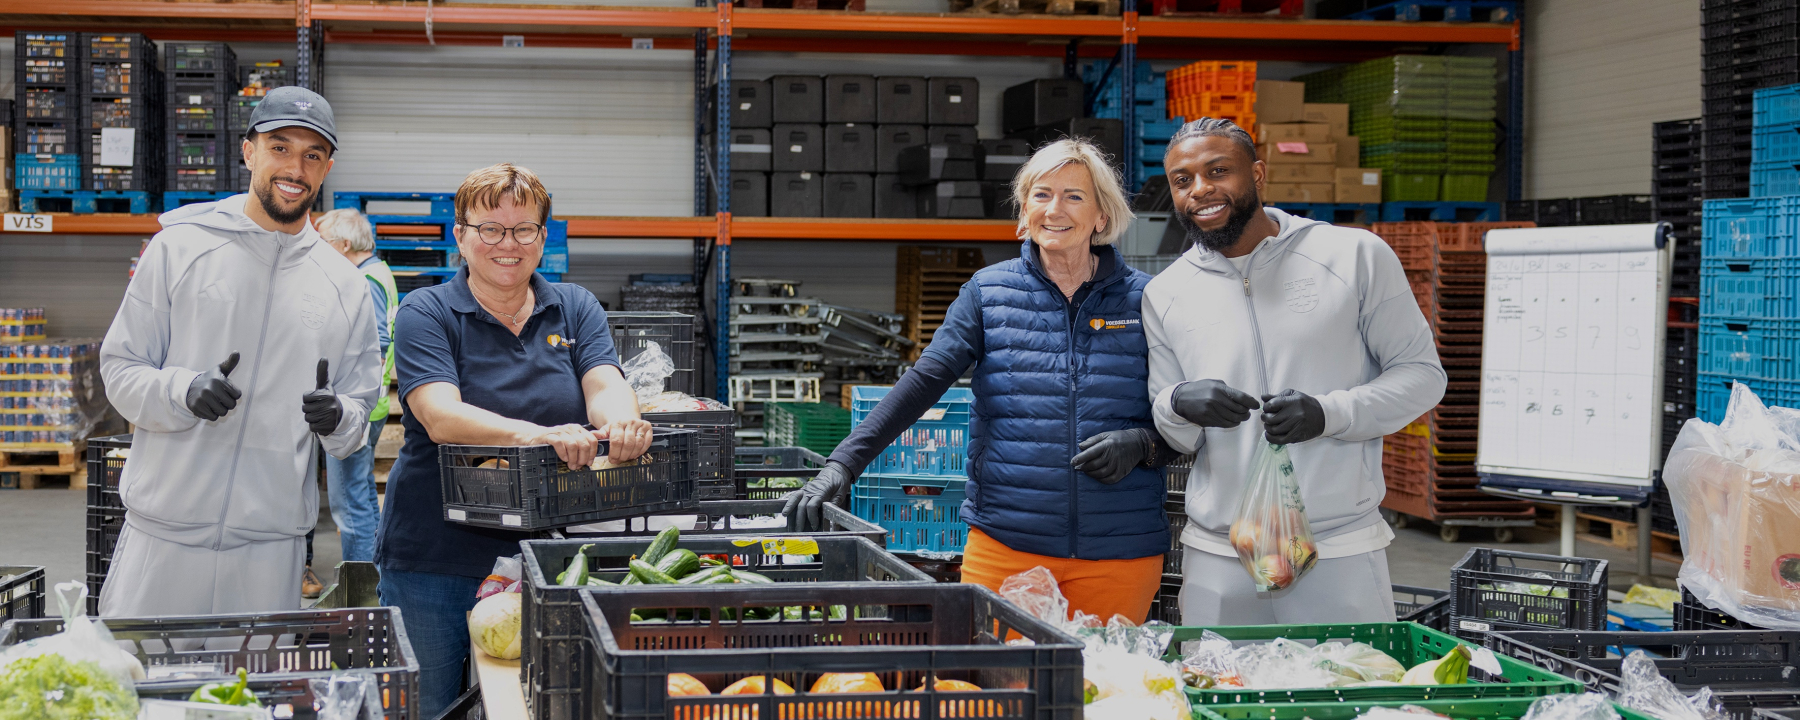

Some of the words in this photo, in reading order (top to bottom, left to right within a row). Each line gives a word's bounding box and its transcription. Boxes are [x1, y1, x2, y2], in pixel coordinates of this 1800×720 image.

[13, 216, 44, 229] VIS
[1527, 326, 1545, 342] 3
[1555, 327, 1568, 339] 5
[1588, 325, 1601, 349] 7
[1744, 545, 1751, 557] EU
